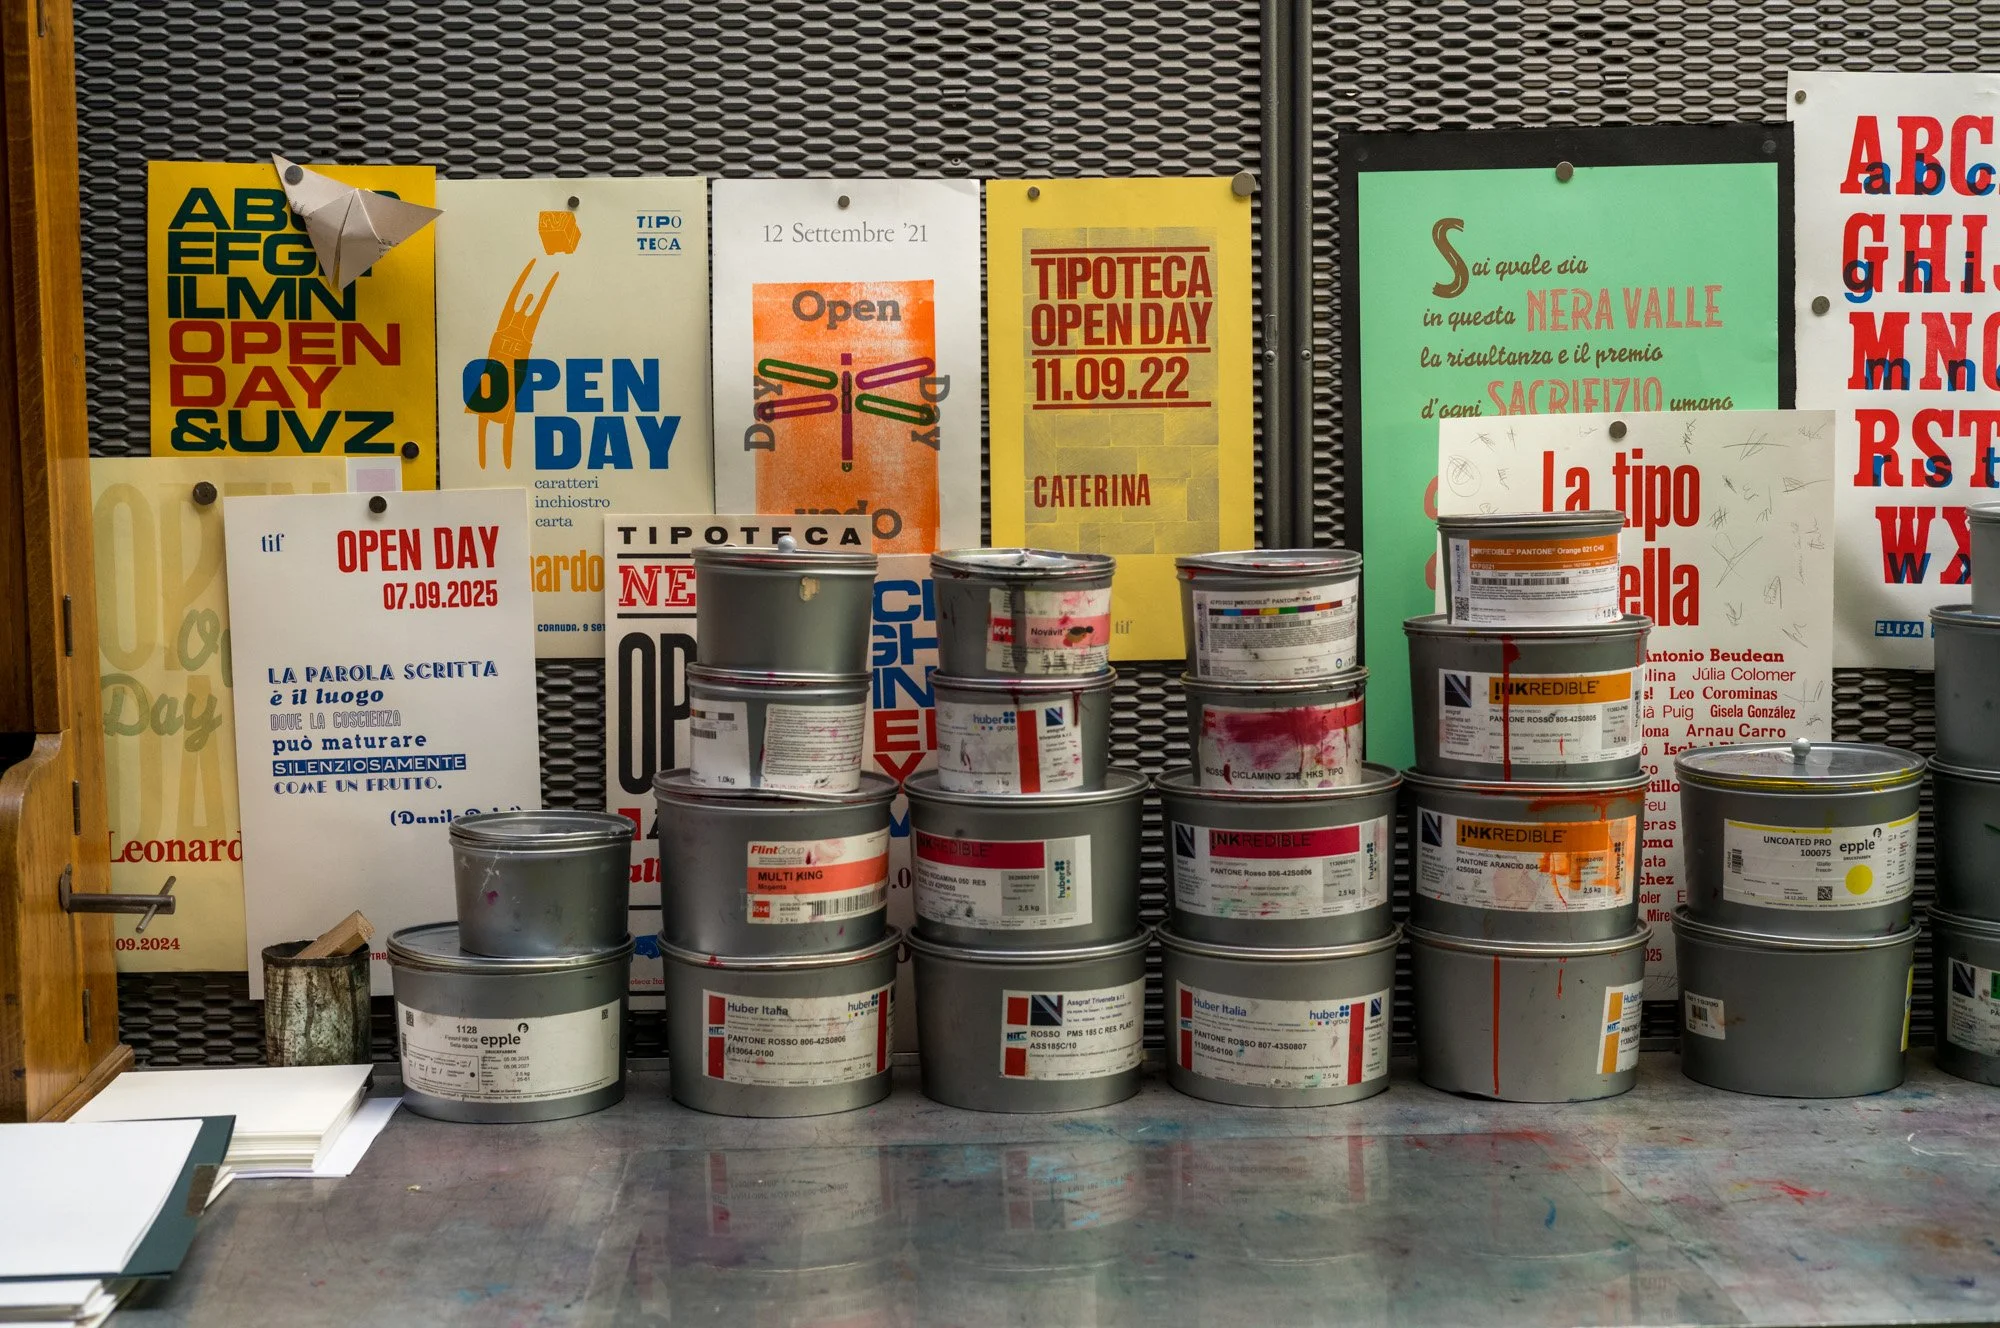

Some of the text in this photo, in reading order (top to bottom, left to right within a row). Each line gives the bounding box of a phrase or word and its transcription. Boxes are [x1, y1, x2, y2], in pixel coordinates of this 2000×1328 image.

[637, 215, 682, 229] TIPO
[763, 222, 928, 243] 12 Settembre '21
[637, 237, 682, 250] TECA
[1843, 212, 2000, 293] GHI
[1496, 254, 1551, 281] quale
[1557, 254, 1588, 275] sia
[1031, 256, 1213, 300] TIPOTECA
[168, 276, 356, 321] ILMN
[792, 290, 901, 330] Open
[1423, 285, 1723, 332] in questa NERA VALLE
[1031, 301, 1213, 347] OPEN DAY
[169, 321, 400, 366] OPEN
[1420, 344, 1663, 369] la risultanza e il premio
[463, 358, 660, 413] OPEN
[1032, 356, 1190, 401] 11.09.22
[170, 365, 342, 409] DAY
[1487, 376, 1662, 416] SACRIFIZIO
[1670, 394, 1733, 412] umano
[534, 416, 682, 470] DAY
[534, 476, 599, 489] caratteri
[1034, 473, 1151, 508] CATERINA
[535, 496, 610, 508] inchiostro
[1612, 448, 1700, 541] tipo
[535, 516, 573, 527] carta
[262, 534, 284, 552] tif
[617, 525, 862, 547] TIPOTECA
[337, 525, 499, 572] OPEN DAY
[1516, 548, 1553, 556] PANTONE
[1557, 547, 1581, 556] Orange
[383, 580, 498, 610] 07.09.2025
[1876, 621, 1923, 637] ELISA
[1710, 649, 1785, 663] Beudean
[268, 660, 498, 684] LA PAROLA SCRITTA
[1692, 667, 1796, 682] Júlia Colomer
[270, 688, 384, 707] è il luogo
[1670, 686, 1778, 700] Leo Corominas
[270, 710, 401, 731] DOVE LA COSCIENZA
[973, 714, 1002, 724] huber
[1489, 715, 1524, 724] PANONE
[1527, 715, 1554, 724] ROSSO
[1663, 705, 1796, 720] Puig Gisela González
[1686, 723, 1786, 738] Arnau Carro
[272, 735, 427, 755] può maturare
[273, 754, 466, 776] SILENZIOSAMENTE
[1232, 766, 1344, 780] CICLAMINO HKS TIPO
[274, 776, 442, 794] COME UN FRUTTO.
[1763, 836, 1832, 846] UNCOATED PRO
[1839, 838, 1875, 854] epple
[1801, 849, 1831, 857] 100075
[1456, 857, 1488, 867] PANTONE
[1490, 862, 1524, 870] ARANCIO
[758, 870, 823, 882] MULTI KING
[1211, 868, 1242, 876] PANTONE
[1244, 869, 1266, 877] Rosso
[115, 937, 180, 951] 09.2024
[728, 1002, 788, 1016] Huber Italia
[847, 999, 872, 1012] huber
[1067, 997, 1091, 1007] Assgraf
[1194, 998, 1247, 1017] Huber Italia
[1309, 1010, 1339, 1020] huber
[456, 1024, 477, 1034] 1128
[1031, 1030, 1060, 1038] ROSSO
[1066, 1028, 1083, 1037] PMS
[1085, 1027, 1097, 1036] 185
[1098, 1026, 1103, 1034] C
[1104, 1025, 1118, 1033] RES.
[481, 1033, 521, 1048] epple
[728, 1034, 765, 1045] PANTONE
[768, 1036, 797, 1046] ROSSO
[1030, 1042, 1077, 1050] ASS185C/10
[1194, 1029, 1226, 1044] PANTONE
[1228, 1037, 1257, 1047] ROSSO
